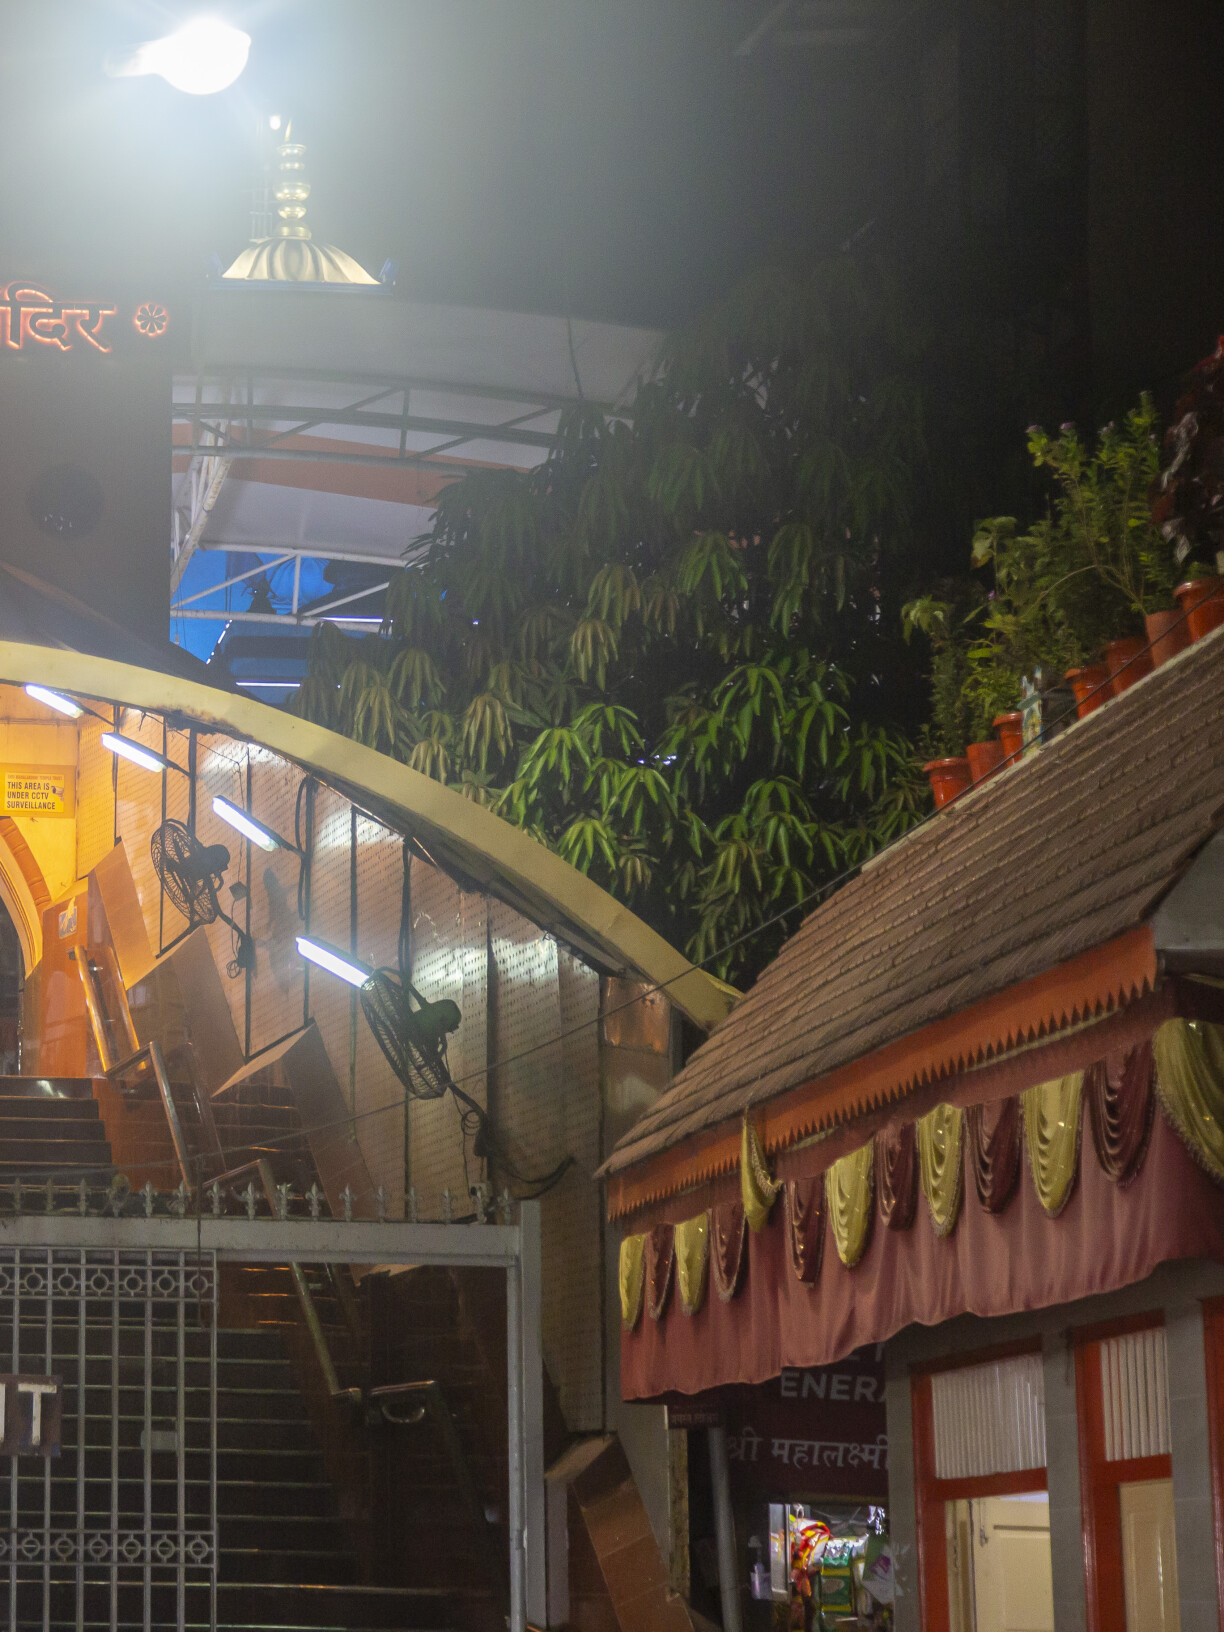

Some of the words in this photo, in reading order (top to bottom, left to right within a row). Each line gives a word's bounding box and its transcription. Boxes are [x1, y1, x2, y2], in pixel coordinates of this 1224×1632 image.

[7, 781, 23, 790] THIS
[24, 782, 42, 790] AREA
[43, 782, 50, 791] IS
[7, 791, 30, 799] UNDER
[31, 792, 49, 800] CCTV
[6, 800, 56, 810] SURVEILLANCE
